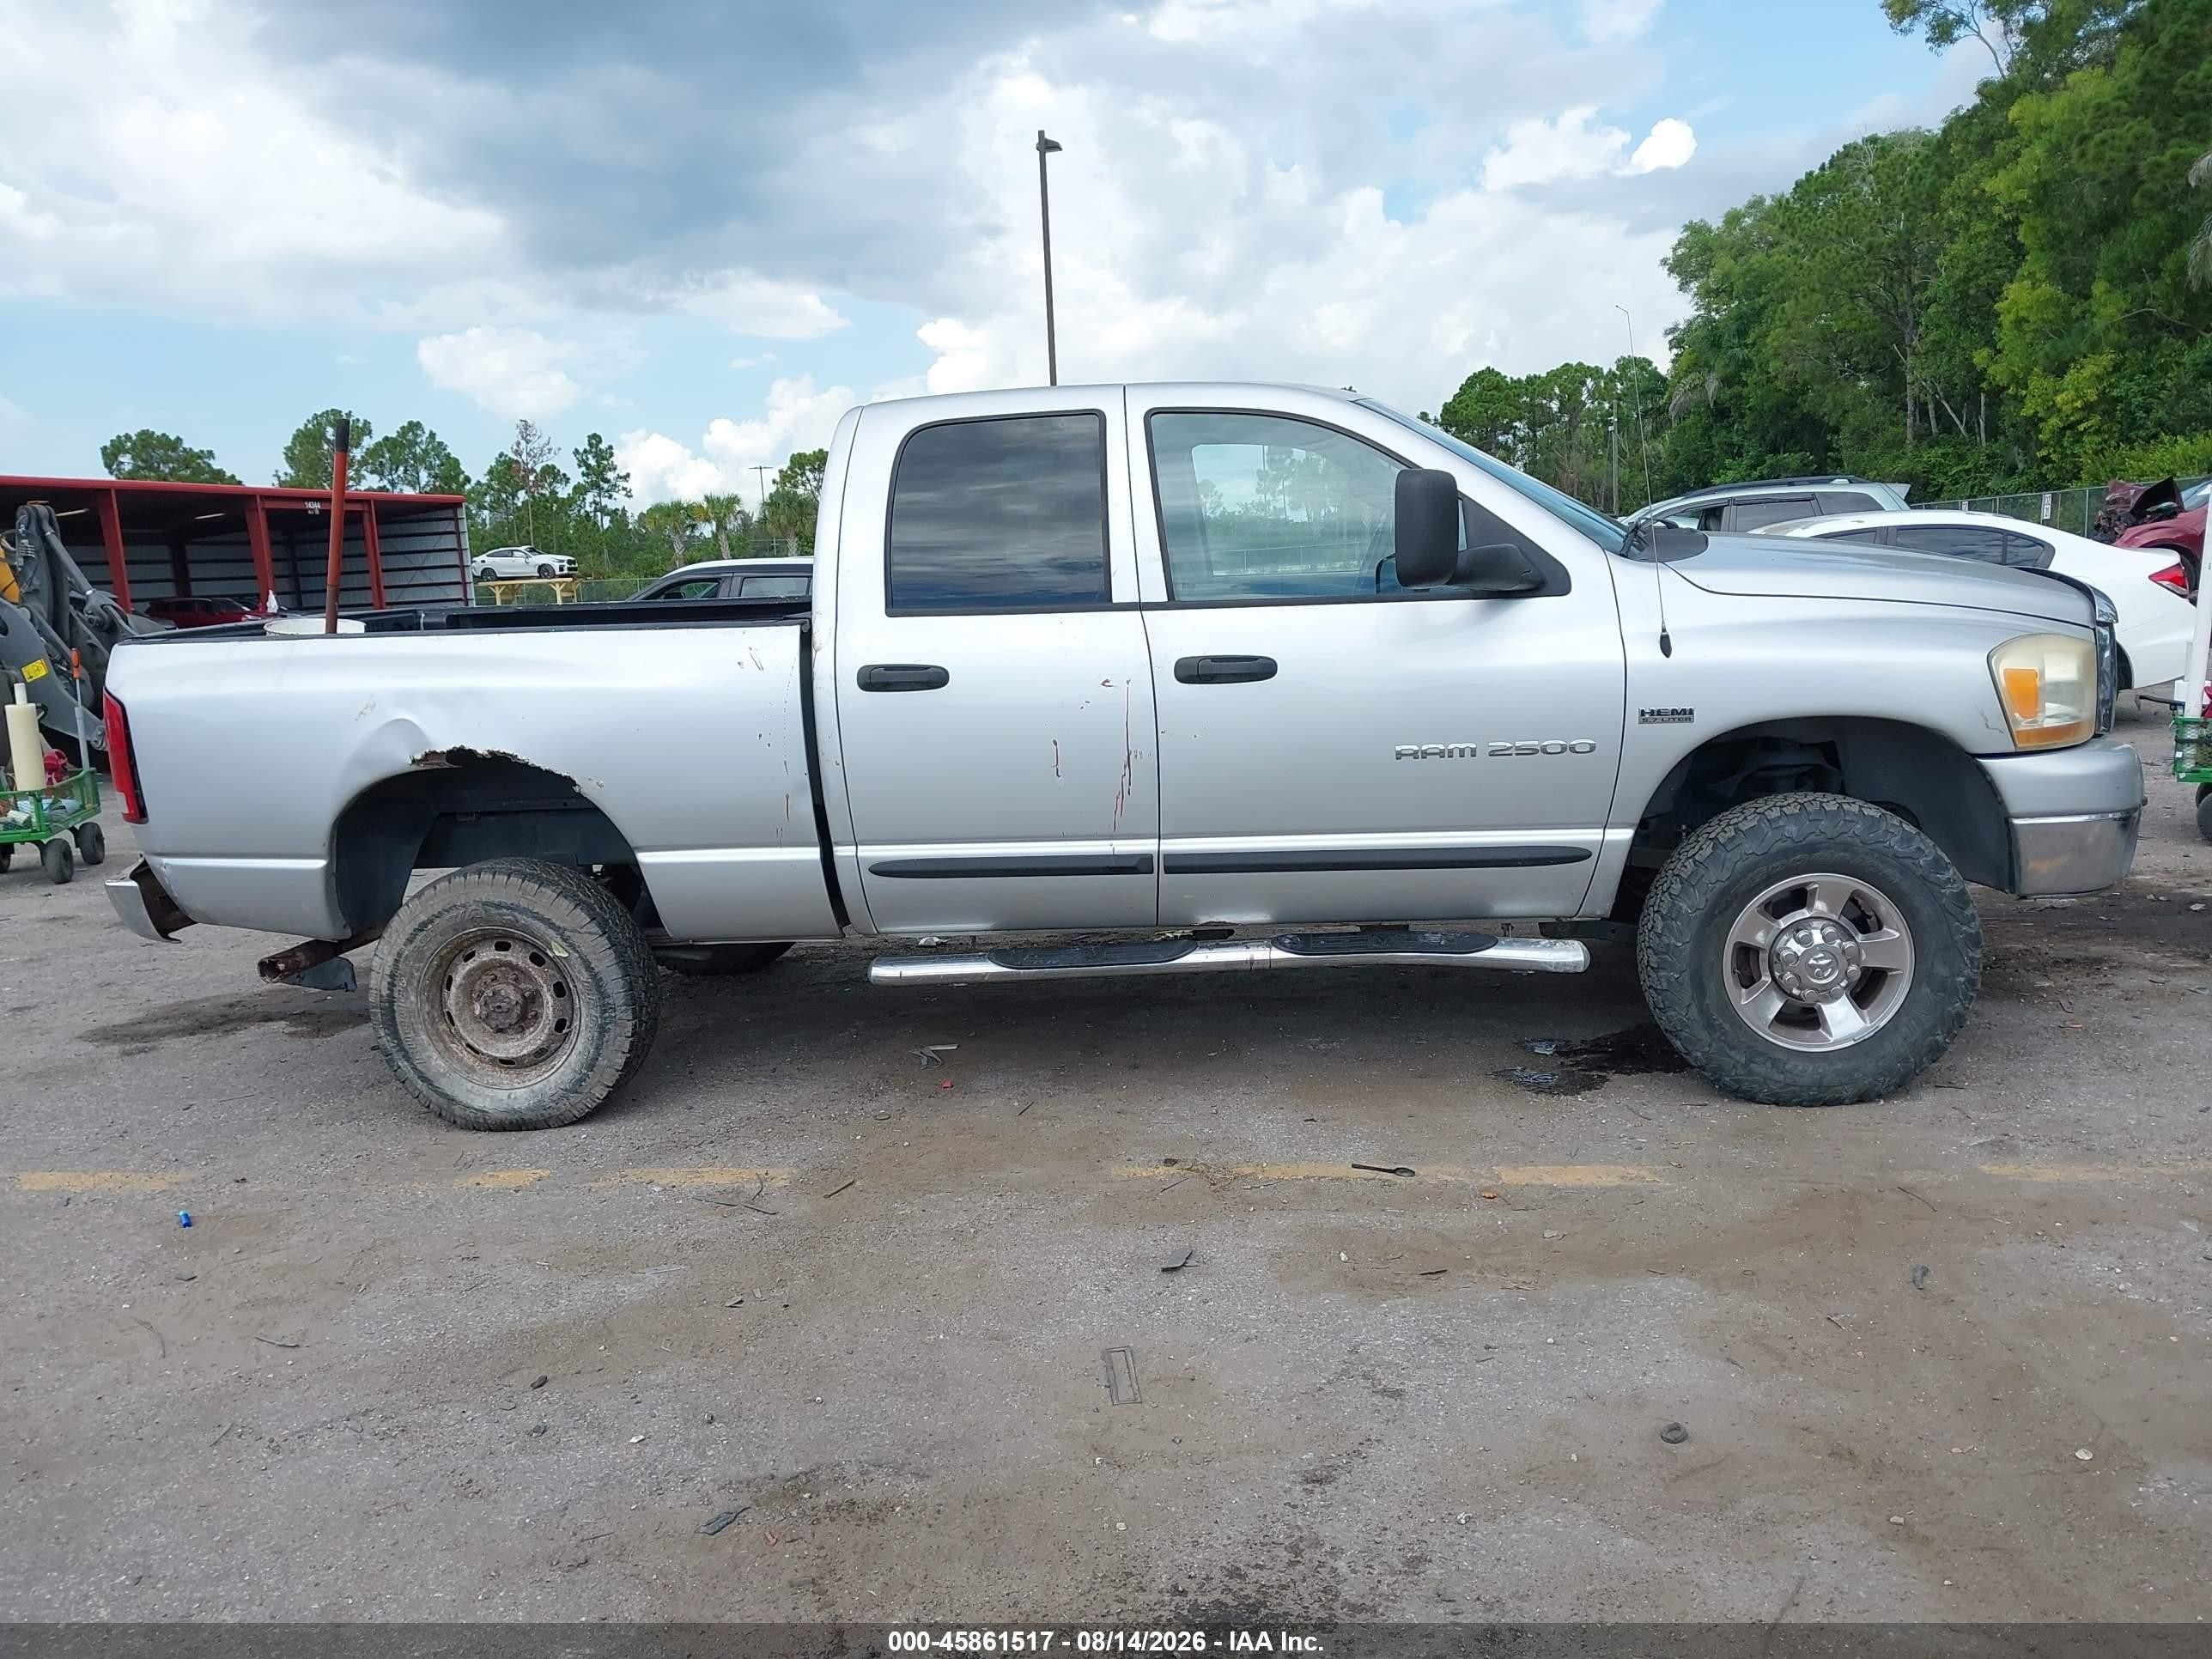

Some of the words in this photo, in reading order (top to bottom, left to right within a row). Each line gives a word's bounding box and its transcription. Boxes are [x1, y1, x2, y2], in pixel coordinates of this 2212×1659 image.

[1640, 707, 1693, 716] HEMI
[1395, 742, 1477, 761] RAM
[1488, 738, 1596, 757] 2500
